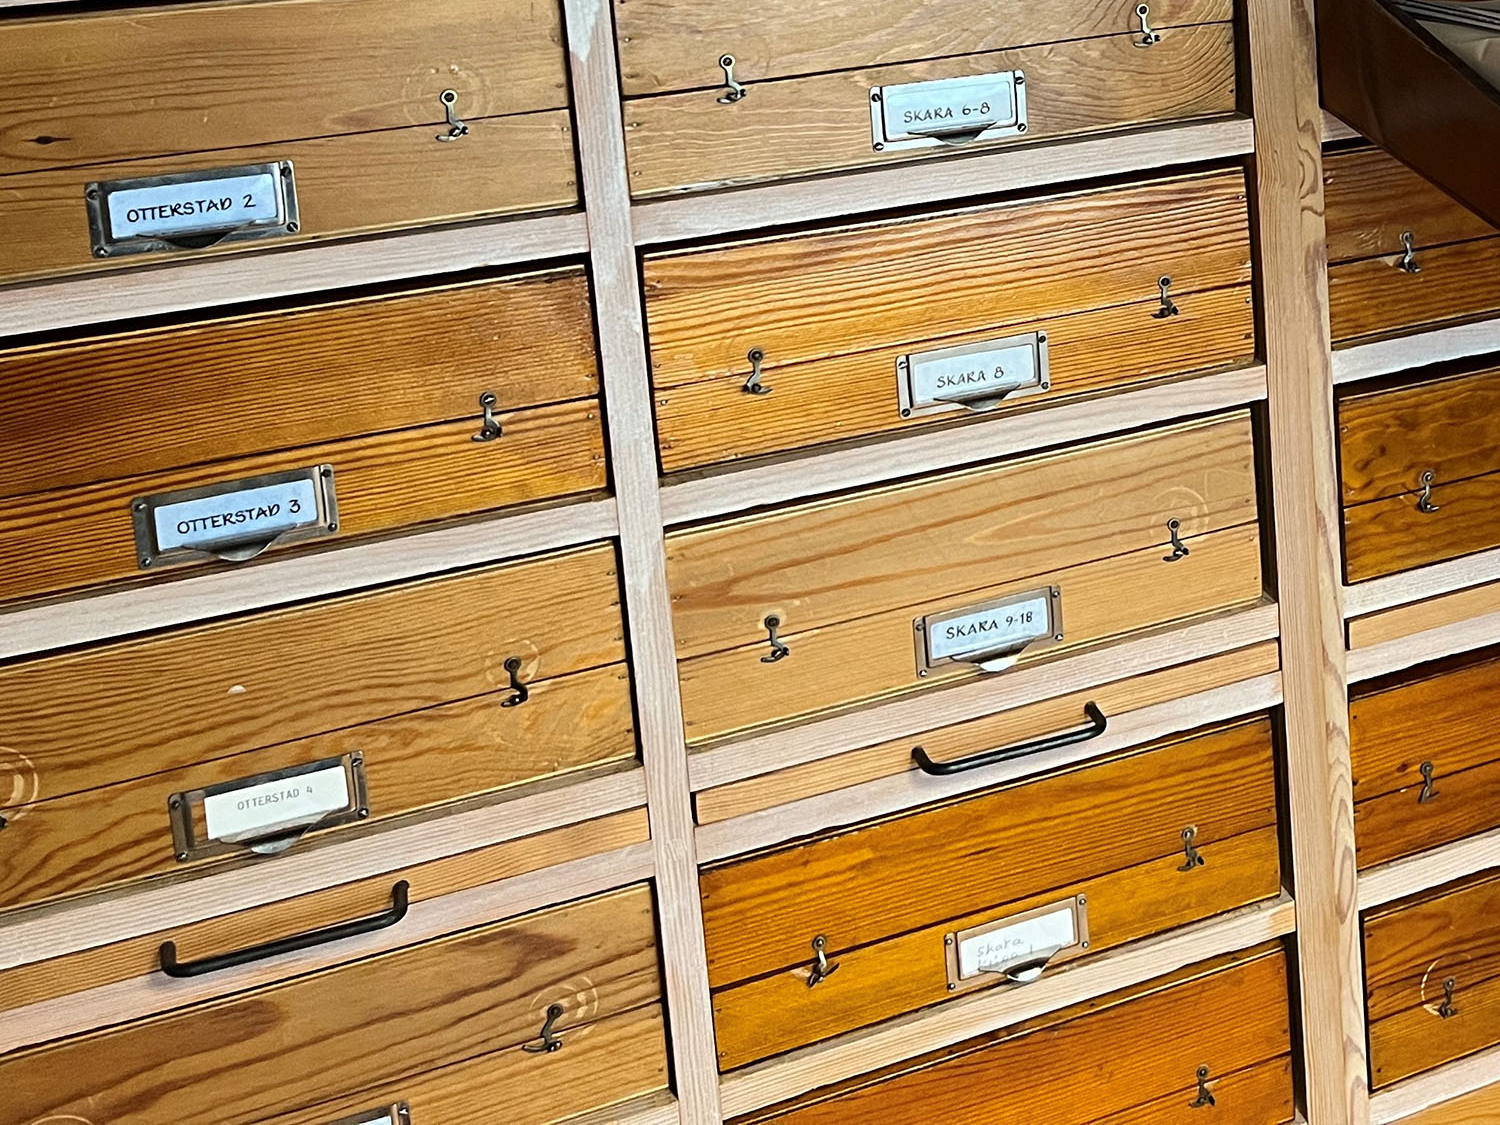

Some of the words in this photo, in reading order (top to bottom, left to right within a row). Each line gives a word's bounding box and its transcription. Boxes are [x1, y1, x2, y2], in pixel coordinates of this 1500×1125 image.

[903, 106, 953, 124] SKARA
[962, 102, 991, 117] 6-8
[127, 197, 233, 223] OTTERSTAD
[242, 194, 256, 209] 2
[937, 370, 986, 389] SKARA
[994, 366, 1005, 379] 8
[176, 503, 281, 534] OTTERSTAD
[289, 499, 301, 514] 3
[946, 618, 999, 640] SKARA
[1006, 611, 1033, 627] 9-18
[237, 789, 300, 811] OTTERSTAD
[306, 786, 314, 795] 4
